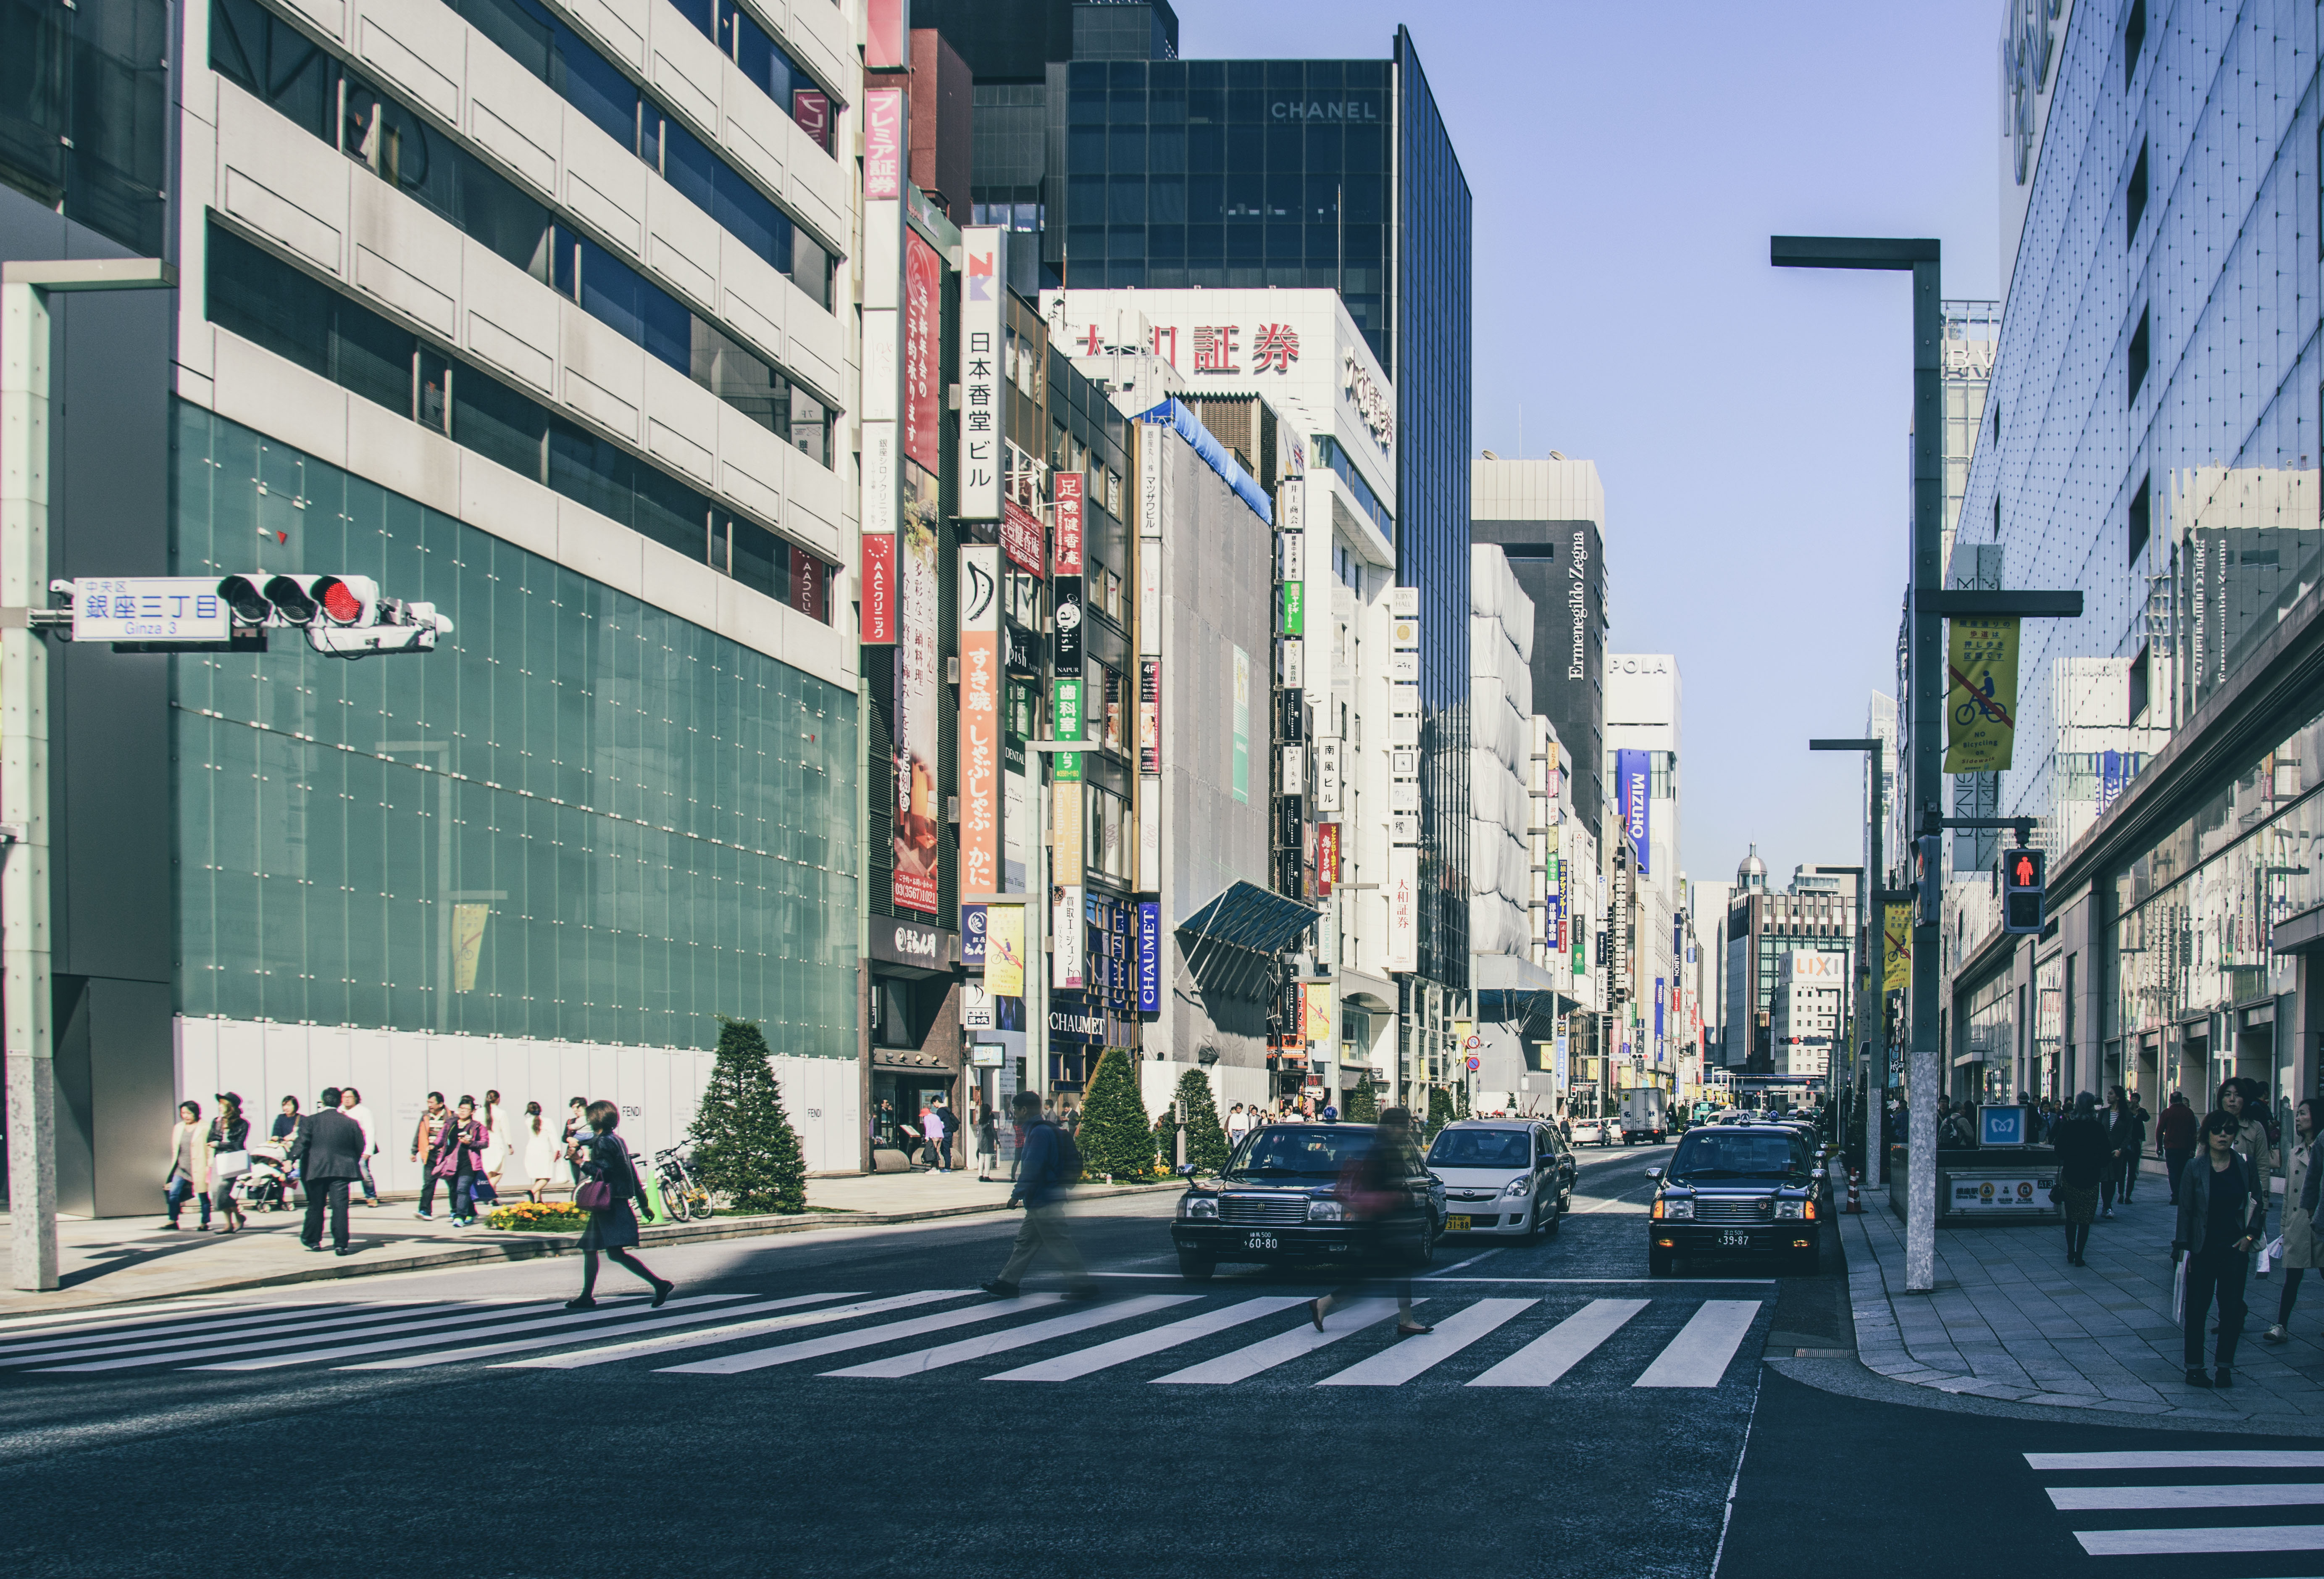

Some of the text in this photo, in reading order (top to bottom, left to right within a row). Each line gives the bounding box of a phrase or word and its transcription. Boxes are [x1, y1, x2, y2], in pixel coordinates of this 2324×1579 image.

[1272, 103, 1376, 118] CHANEL
[869, 94, 897, 193] プレミア証券
[968, 333, 991, 487] 日本香堂ビル
[1146, 476, 1156, 529] マツザワビル
[1290, 484, 1299, 524] 井上商会
[86, 581, 127, 593] 中央区
[85, 595, 218, 619] 銀座三丁目
[874, 561, 883, 638] AACクリニック
[1569, 531, 1588, 681] Ermenegildo Zegna
[125, 622, 177, 635] Ginza 3
[1144, 665, 1156, 674] 4F
[1609, 658, 1667, 673] POLA
[1059, 685, 1076, 768] 歯科室・ムラ
[1963, 739, 1998, 748] Bicycling
[967, 647, 992, 885] すき焼・しゃぶしゃぶ・かに
[1005, 747, 1025, 765] DENTAL
[1325, 745, 1334, 803] 南風ビル
[1632, 773, 1644, 839] MIZUHO
[1057, 786, 1065, 881] Samantha Thavasa
[895, 882, 936, 904] 03(3567)1021
[1397, 879, 1409, 928] 大和証券
[913, 931, 936, 958] らん月
[965, 943, 986, 955] らん
[1143, 910, 1154, 1004] CHAUMET
[1797, 956, 1845, 976] LIXI
[1050, 1012, 1105, 1035] CHAUMET
[623, 1107, 641, 1116] FENDI
[808, 1109, 822, 1117] FENDI
[1249, 1238, 1277, 1248] 60-80
[1723, 1236, 1749, 1245] 39-87
